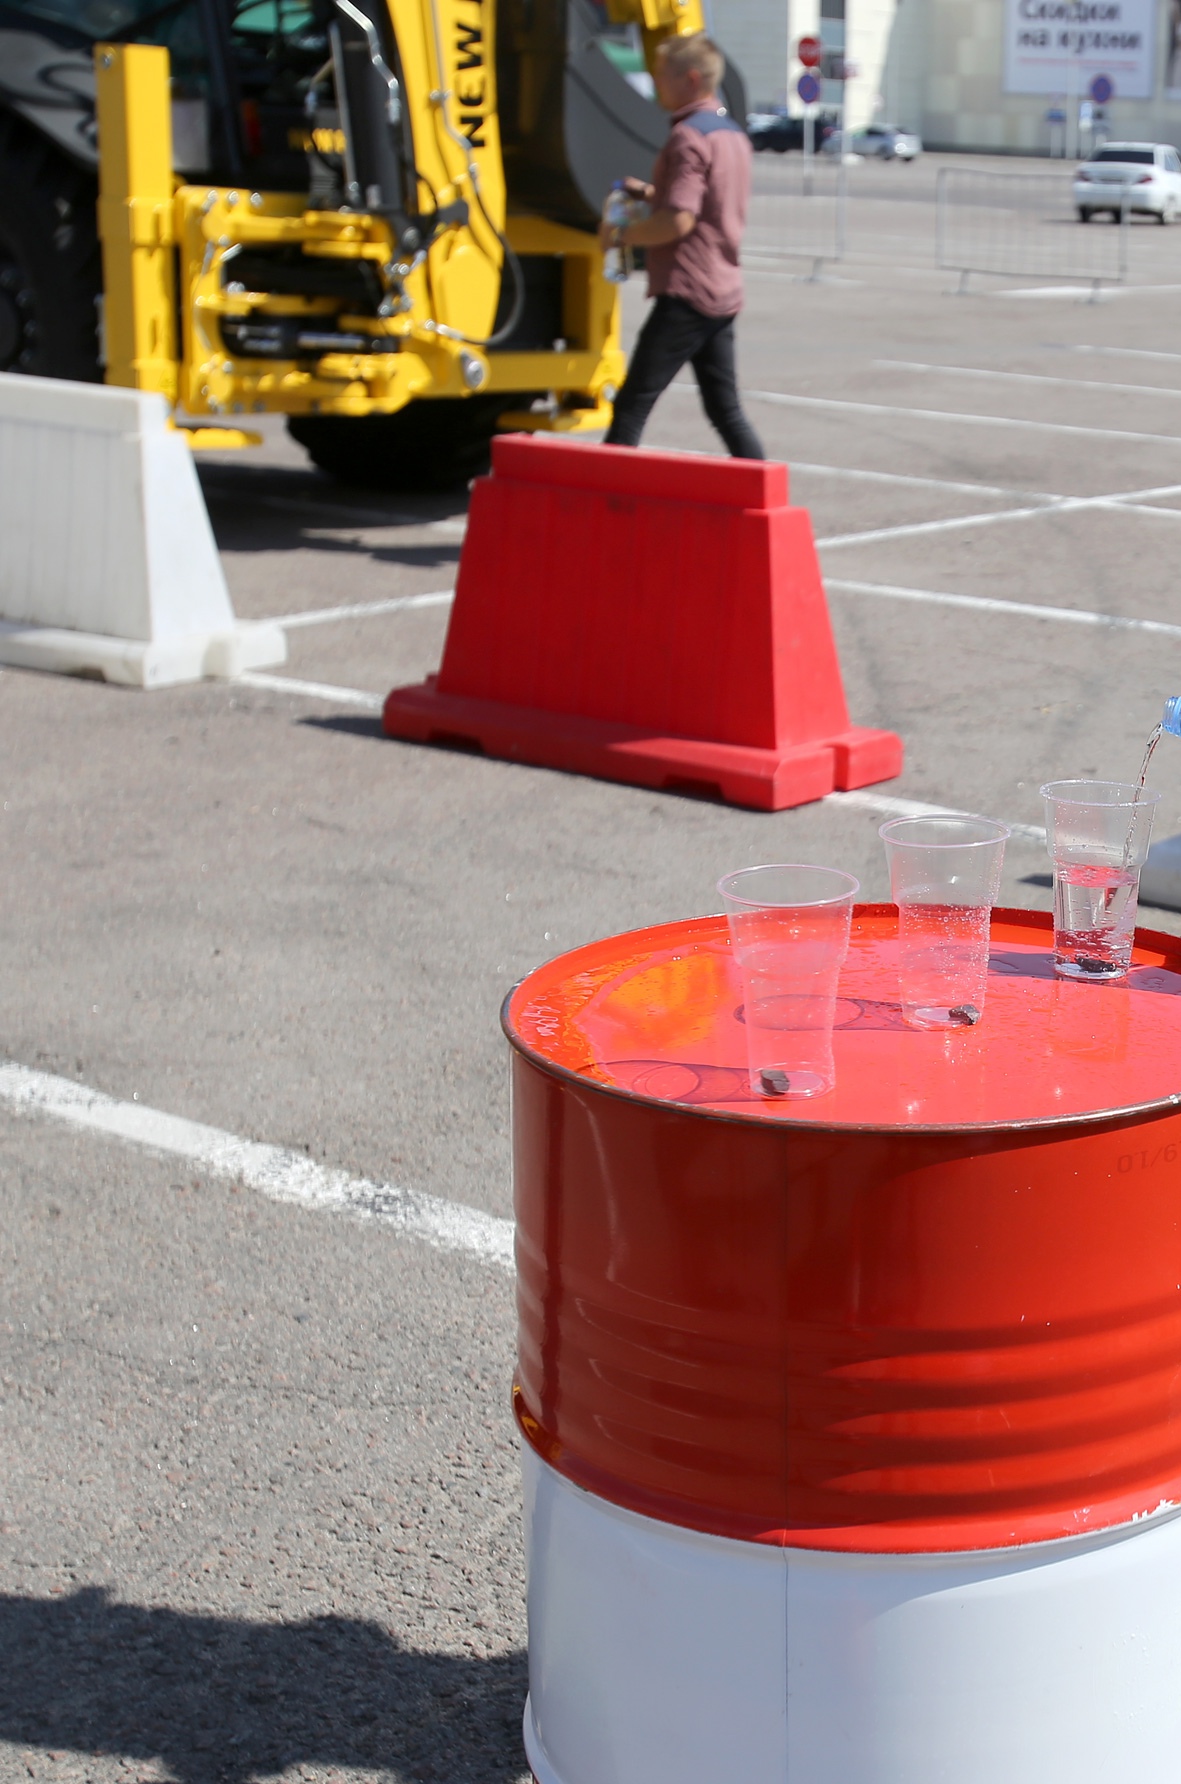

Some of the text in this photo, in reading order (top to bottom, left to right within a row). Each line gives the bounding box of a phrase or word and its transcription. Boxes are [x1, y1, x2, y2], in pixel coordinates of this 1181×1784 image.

[1018, 29, 1141, 54] на кухни
[456, 22, 485, 148] NEW
